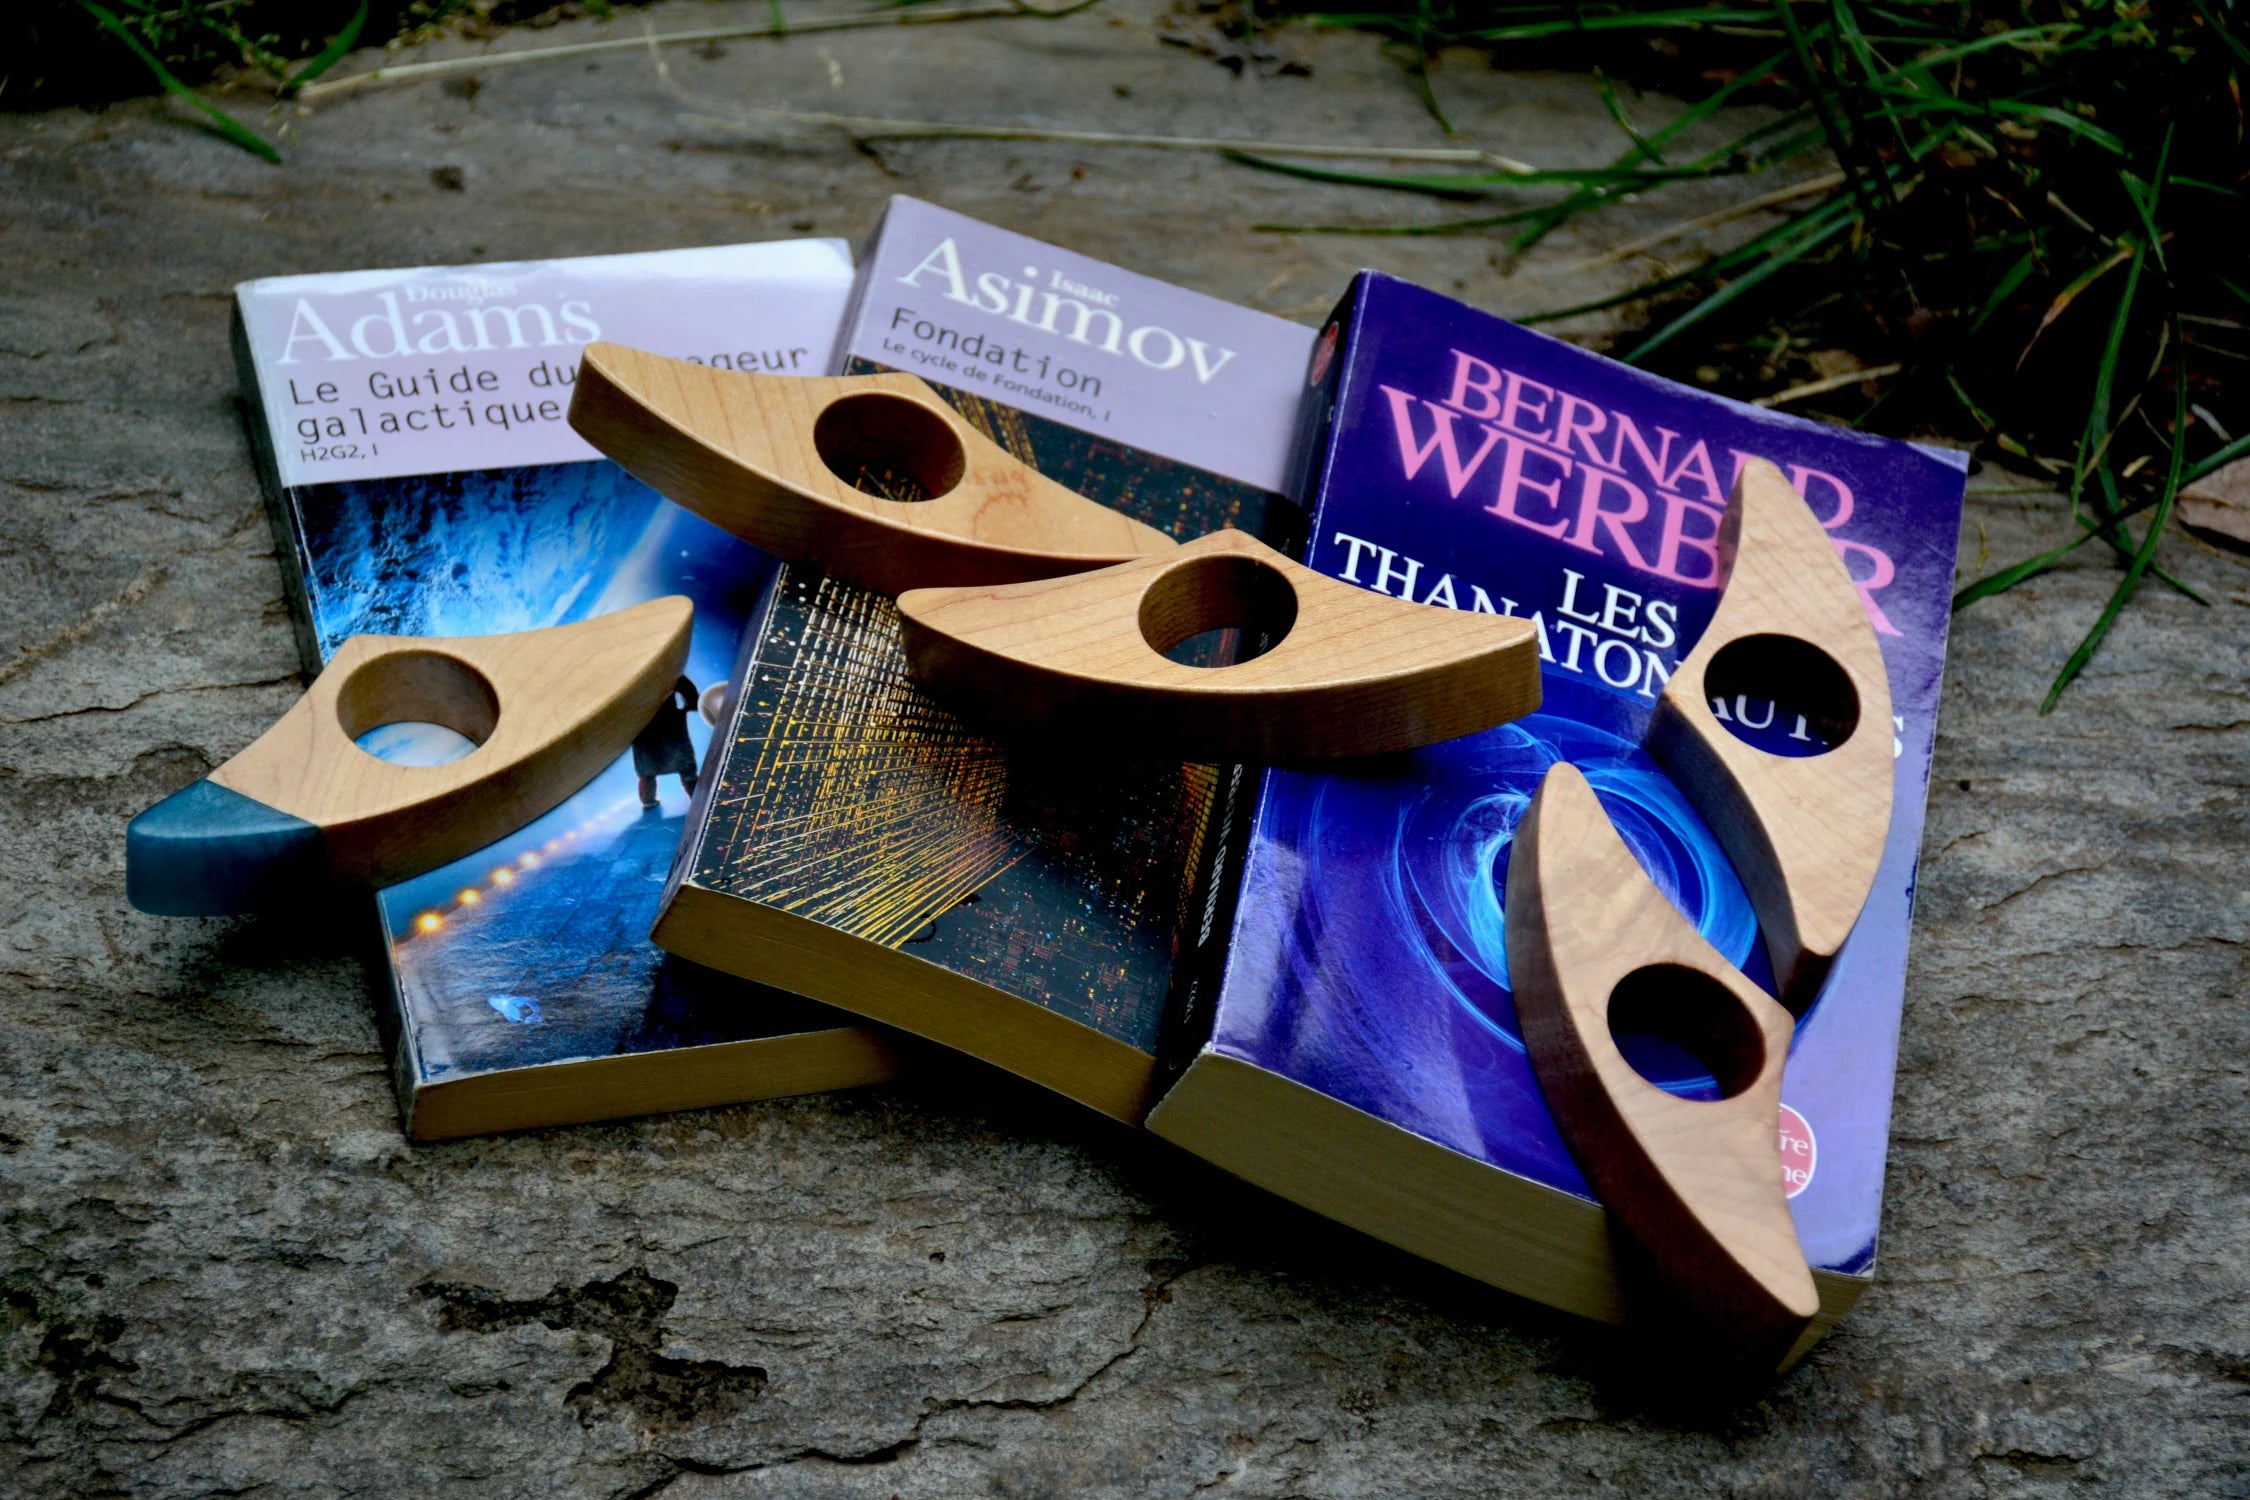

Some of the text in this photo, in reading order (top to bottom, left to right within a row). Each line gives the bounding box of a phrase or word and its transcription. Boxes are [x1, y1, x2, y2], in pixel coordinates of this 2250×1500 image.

[405, 278, 519, 305] Douglas
[895, 236, 1238, 385] Asimov
[1050, 269, 1121, 307] Isaac
[275, 290, 602, 365] Adams
[890, 306, 1104, 398] Fondation
[289, 378, 340, 405] Le
[368, 365, 500, 400] Guide
[528, 360, 578, 388] du
[883, 337, 906, 353] Le
[911, 348, 958, 372] cycle
[962, 362, 988, 381] de
[993, 373, 1097, 420] Fondation,
[297, 399, 562, 445] galactique
[300, 444, 366, 463] H2G2,
[1377, 382, 1905, 638] WERBR
[1556, 567, 1678, 649] LES
[1198, 844, 1228, 948] BERNARD
